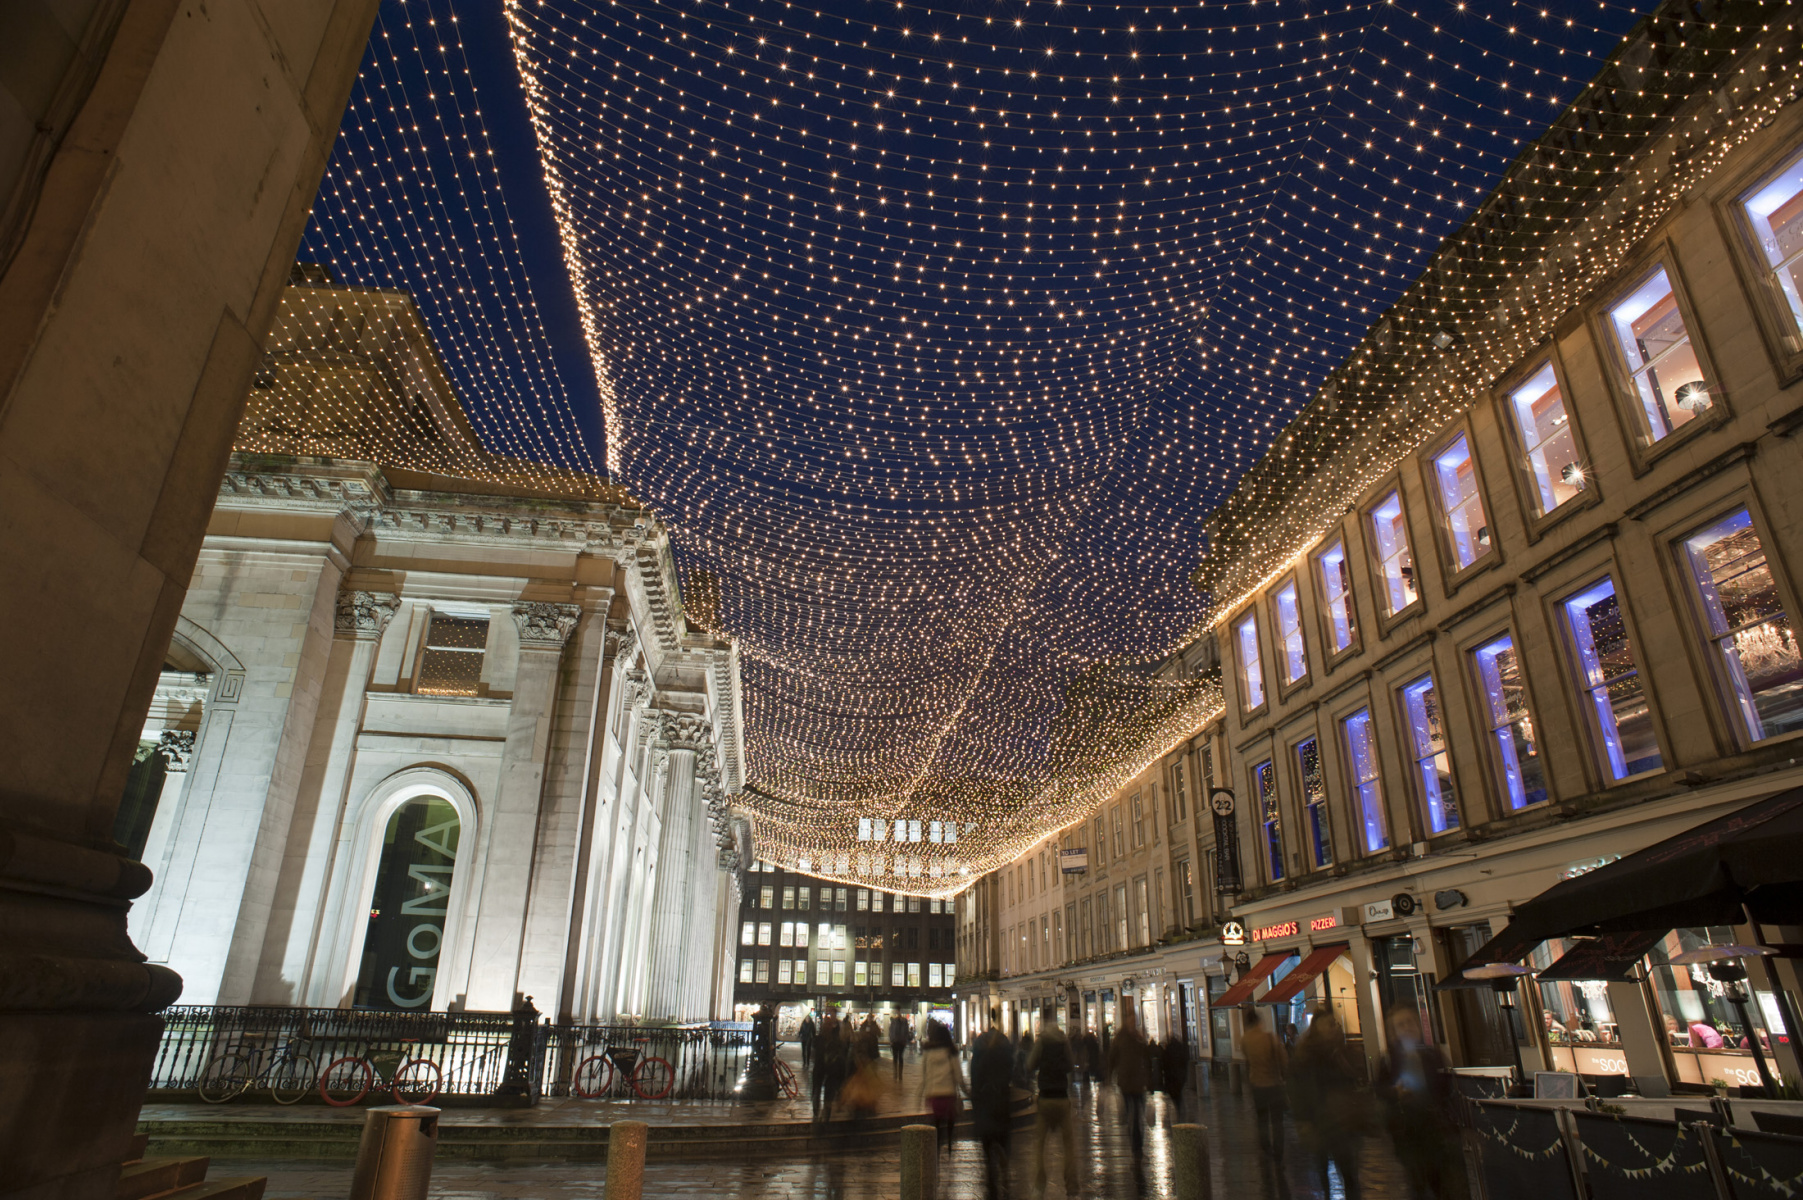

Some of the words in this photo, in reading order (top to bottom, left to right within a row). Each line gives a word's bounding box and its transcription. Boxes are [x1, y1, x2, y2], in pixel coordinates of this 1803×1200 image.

[1310, 916, 1336, 931] PIZZERI
[1252, 928, 1260, 942] DI
[1261, 921, 1298, 940] MAGGIO'S
[1723, 1067, 1734, 1075] the
